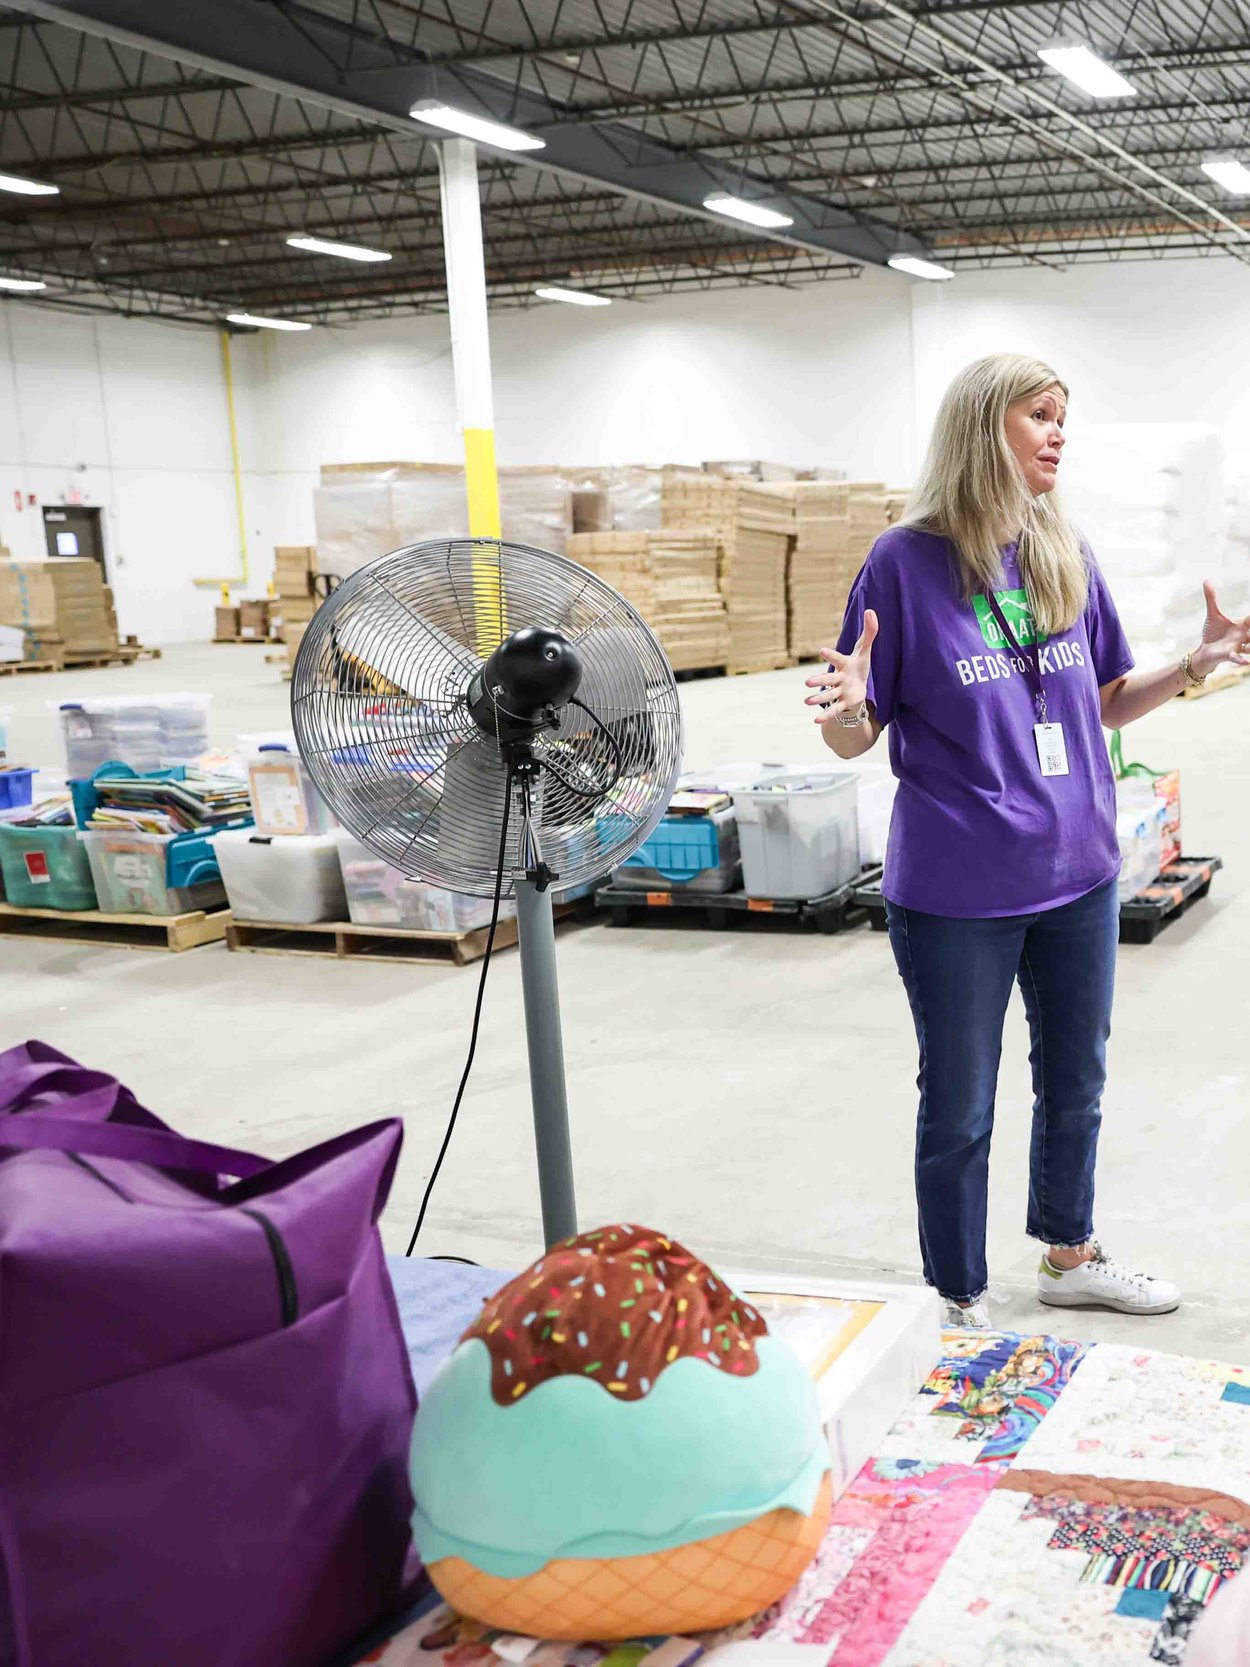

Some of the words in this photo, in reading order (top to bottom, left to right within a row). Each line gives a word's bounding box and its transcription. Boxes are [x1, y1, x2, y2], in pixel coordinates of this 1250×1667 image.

[986, 618, 1036, 642] OAT
[956, 653, 1011, 686] BEDS
[1037, 641, 1085, 676] KIDS
